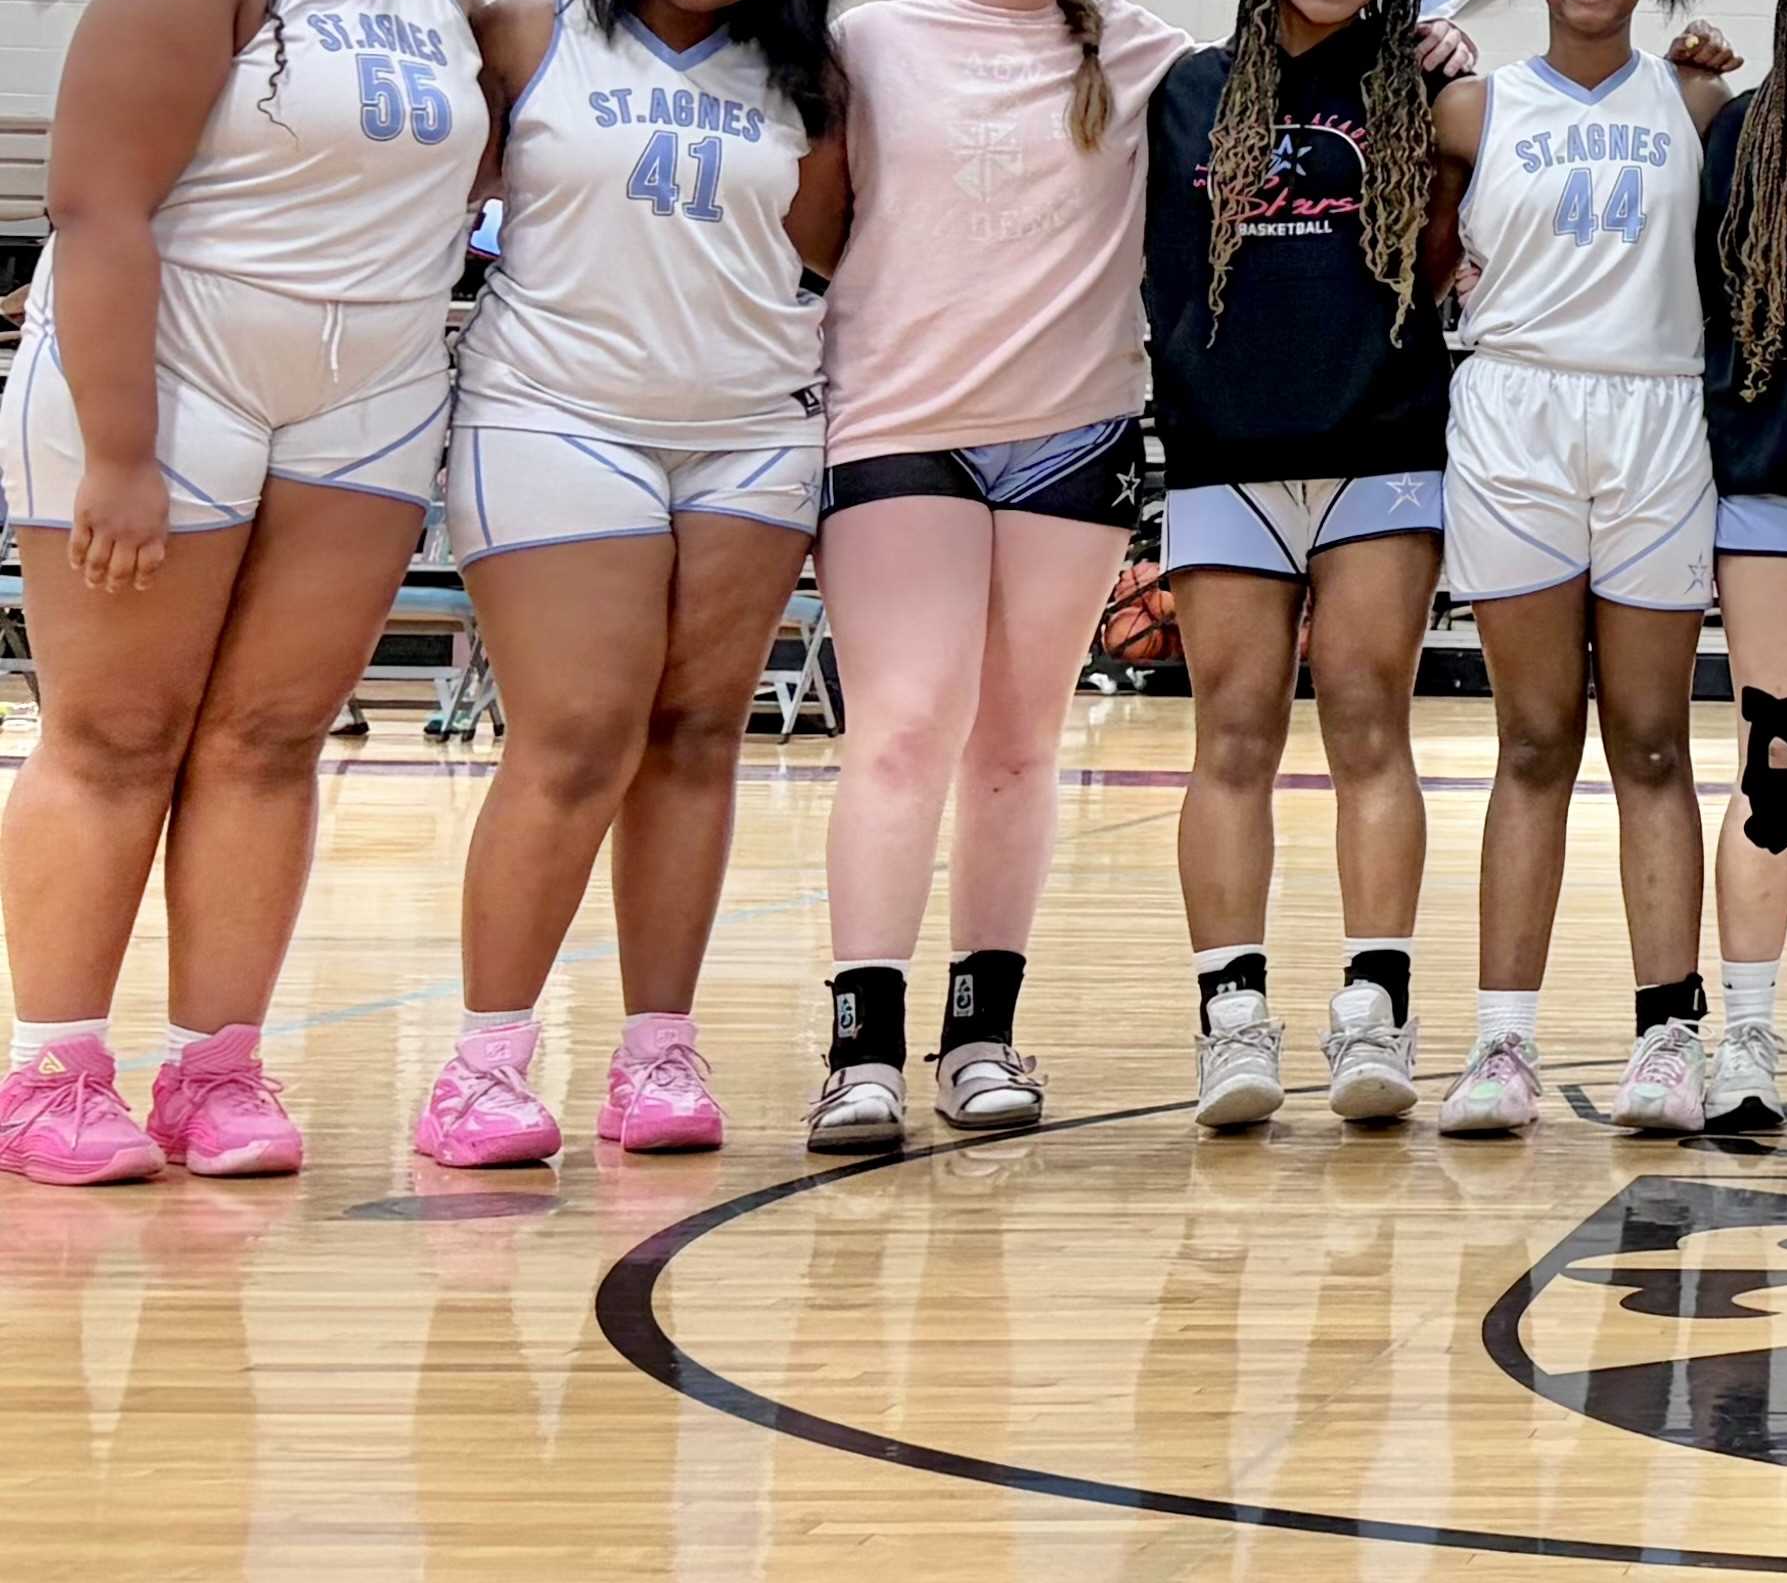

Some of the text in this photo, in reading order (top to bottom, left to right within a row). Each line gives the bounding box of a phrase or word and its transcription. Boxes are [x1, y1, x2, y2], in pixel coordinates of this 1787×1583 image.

[356, 53, 453, 145] 55
[627, 130, 723, 222] 41
[1553, 167, 1646, 247] 44
